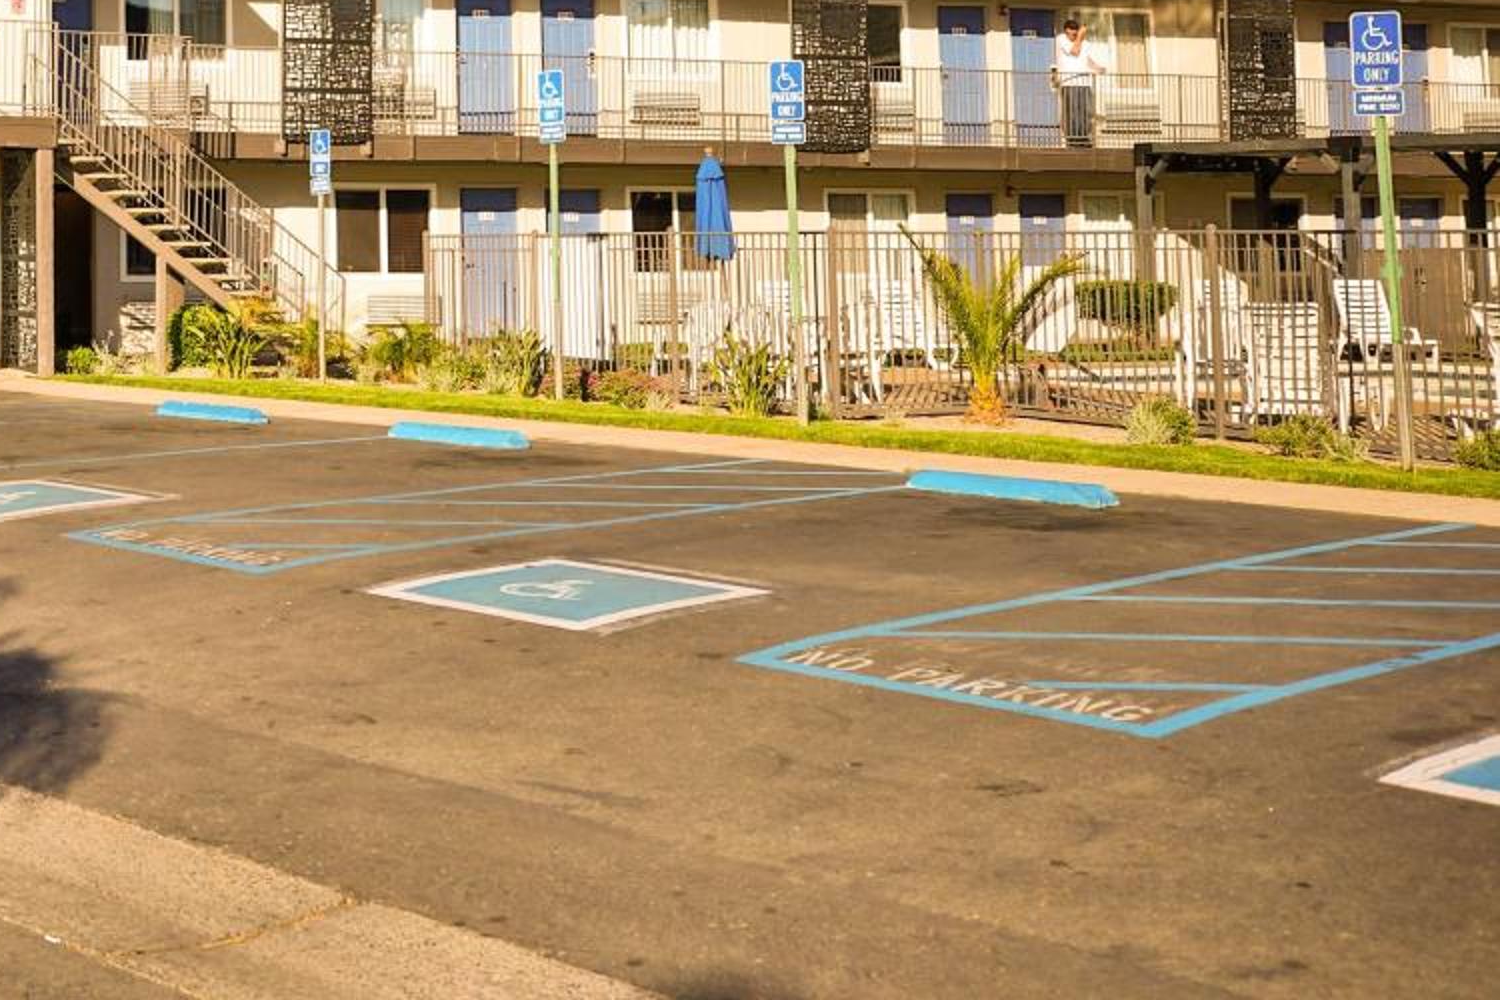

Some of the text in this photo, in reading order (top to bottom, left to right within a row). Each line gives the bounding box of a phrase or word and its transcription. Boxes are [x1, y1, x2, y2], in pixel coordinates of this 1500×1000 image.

[1355, 51, 1399, 66] PARKING
[1363, 67, 1390, 83] ONLY
[787, 650, 1152, 722] NO PARKING
